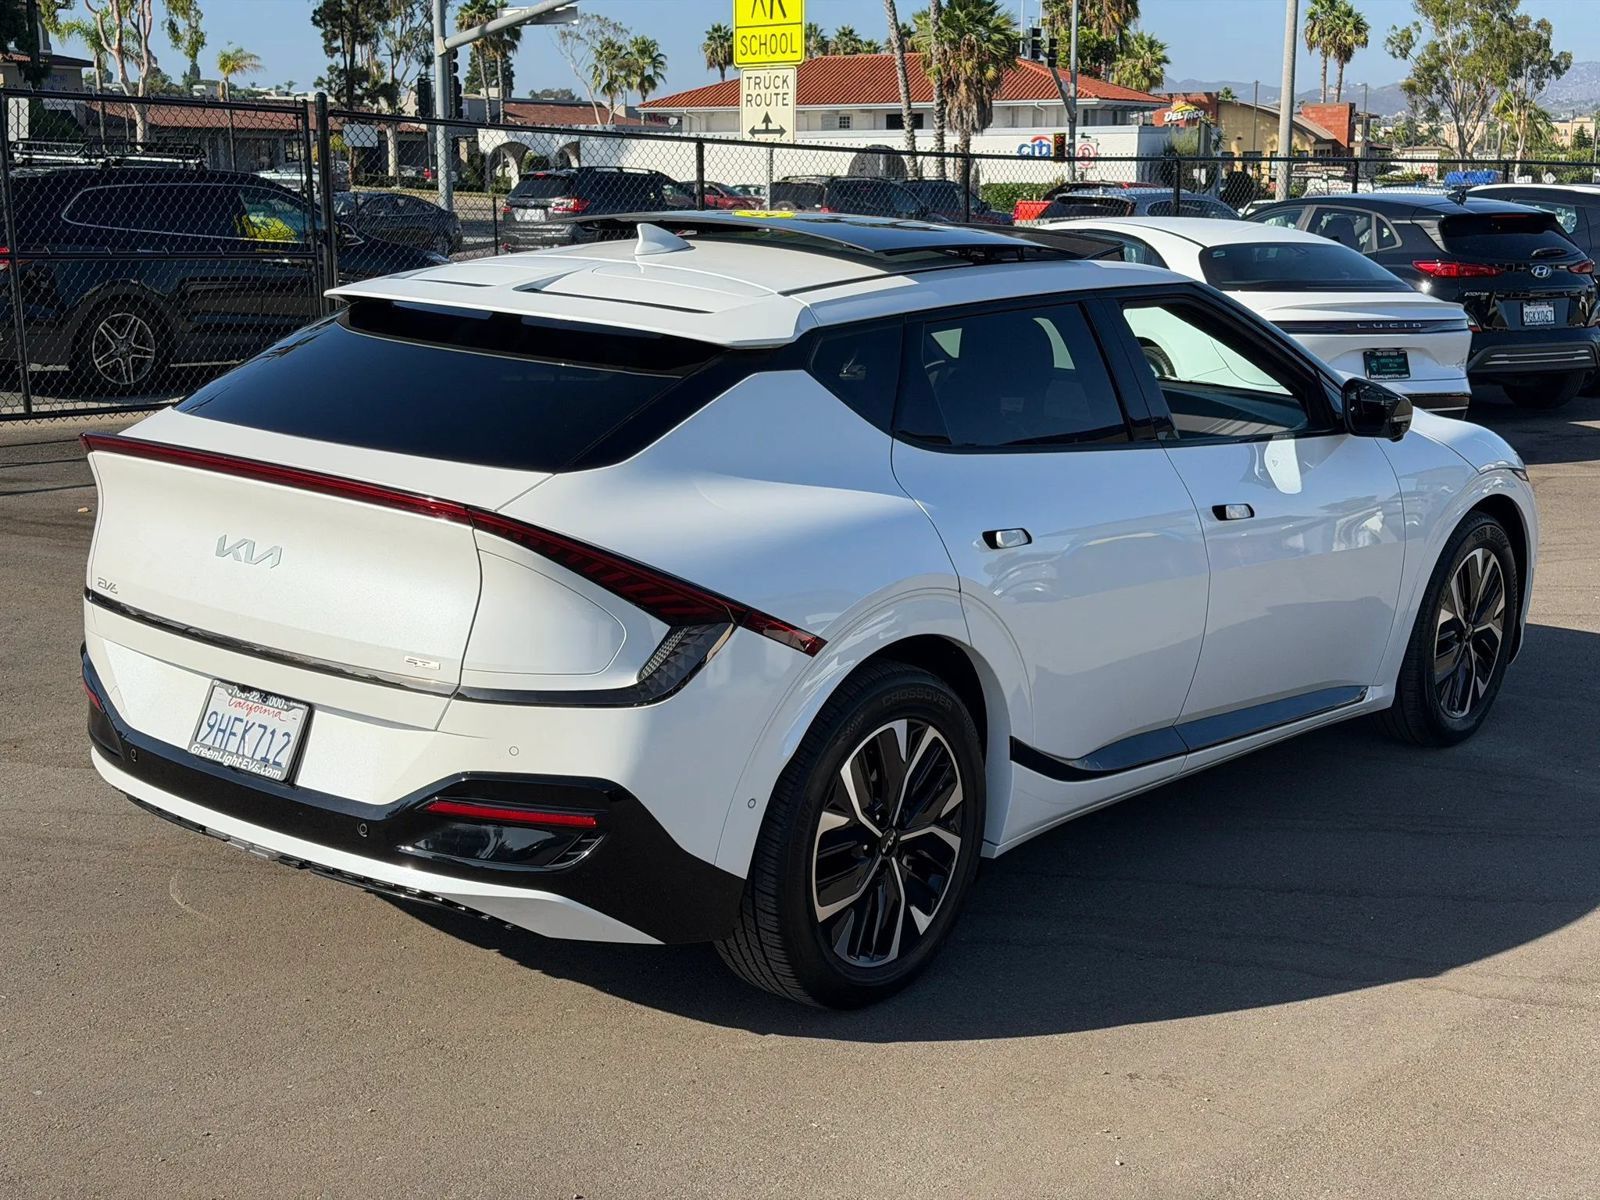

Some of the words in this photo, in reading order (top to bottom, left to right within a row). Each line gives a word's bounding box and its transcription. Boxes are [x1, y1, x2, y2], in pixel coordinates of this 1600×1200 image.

[740, 33, 798, 56] SCHOOL
[745, 74, 790, 91] TRUCK
[745, 92, 790, 108] ROUTE
[1017, 139, 1052, 156] citi
[215, 534, 283, 569] KIA
[228, 698, 286, 721] California
[200, 711, 291, 767] 9HFK712
[191, 744, 282, 779] GreenLightEVs.com
